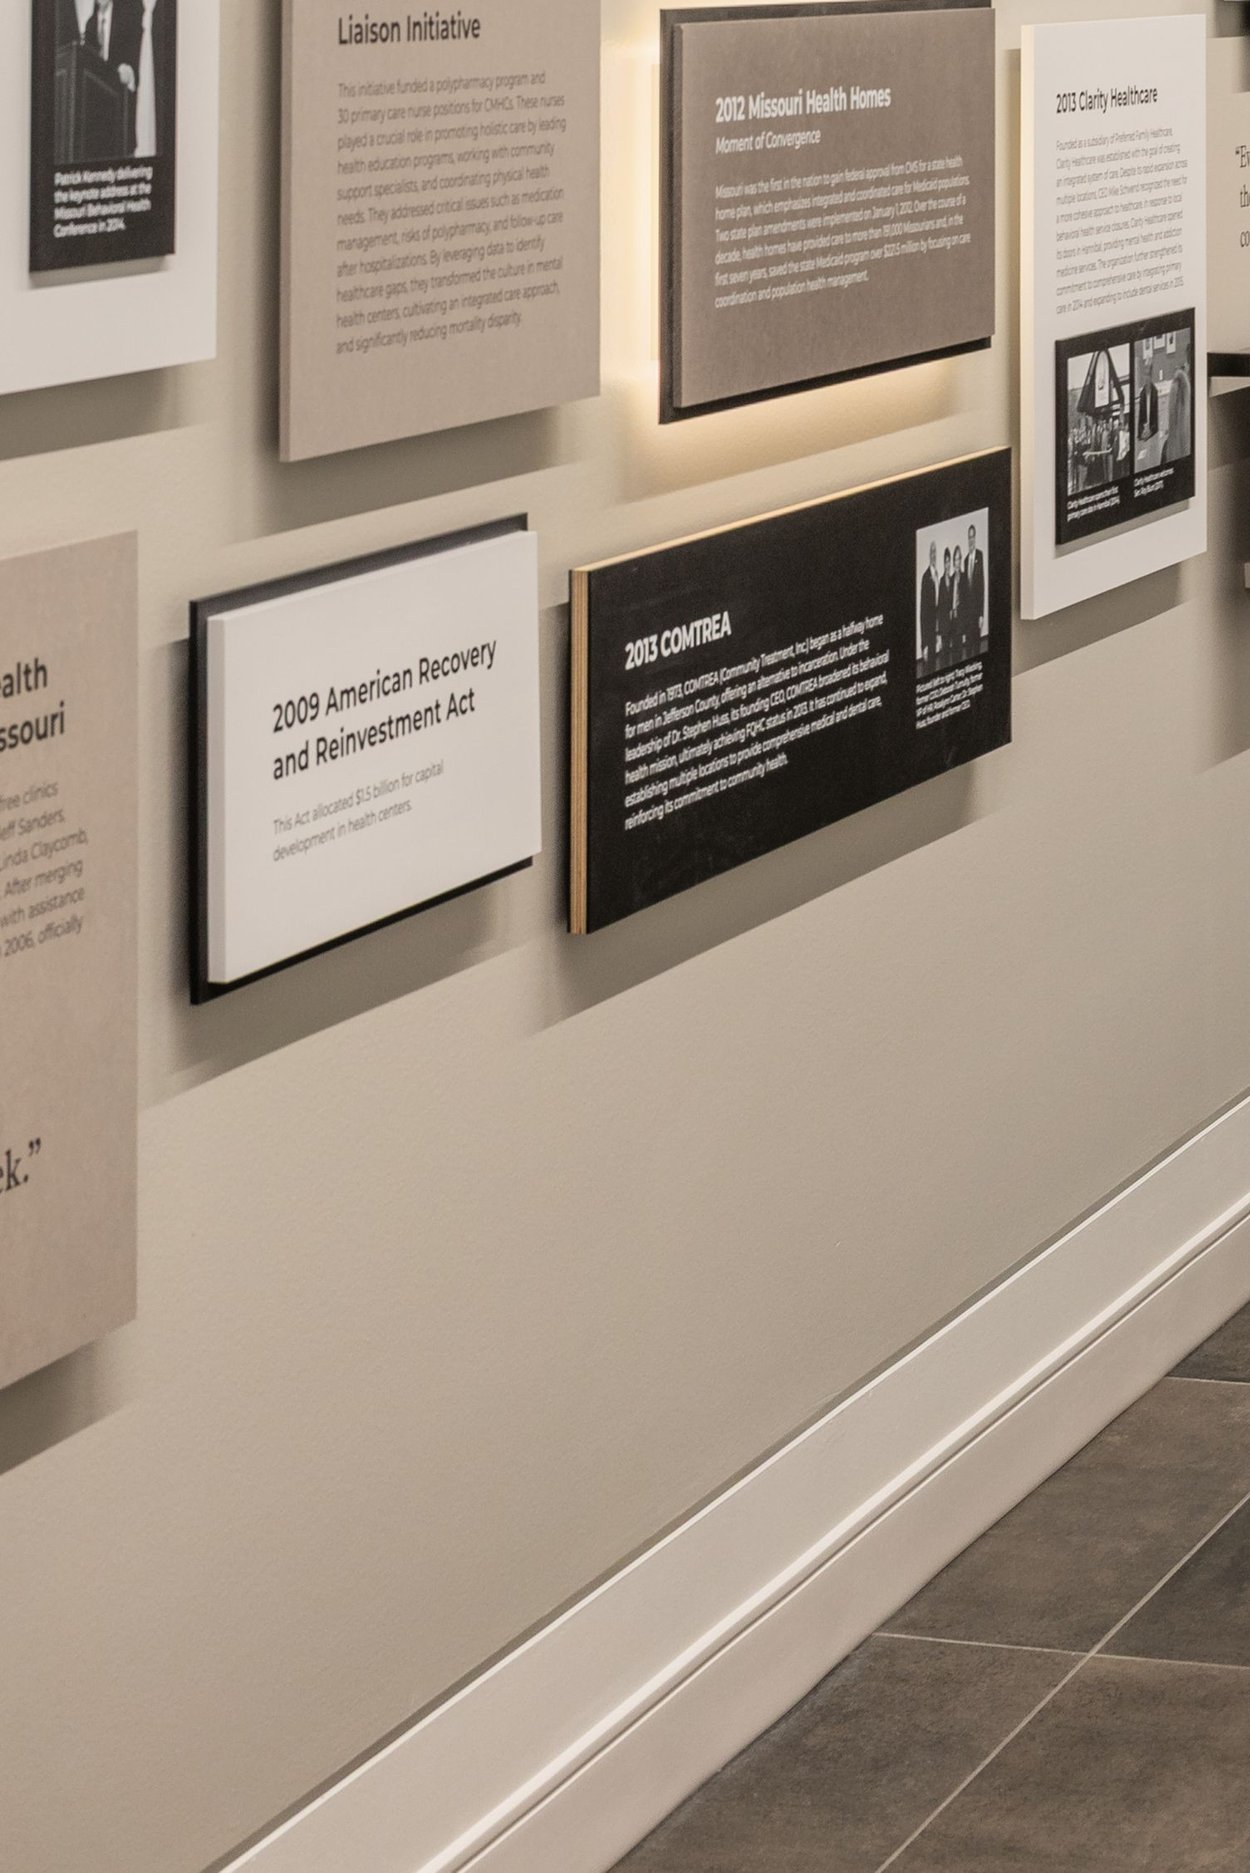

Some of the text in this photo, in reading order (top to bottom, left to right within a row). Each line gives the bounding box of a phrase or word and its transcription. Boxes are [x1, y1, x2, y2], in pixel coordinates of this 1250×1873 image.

[339, 11, 480, 45] Liaison Initiative
[716, 87, 891, 123] 2012 Missouri Health Homes
[1057, 86, 1157, 113] 2013 Clarity Healthcare
[716, 130, 821, 154] Moment of Convergence
[625, 611, 731, 670] 2013 COMTREA
[0, 658, 47, 698] alth
[273, 641, 496, 733] 2009 American Recovery
[274, 688, 475, 780] and Reinvestment Act
[23, 782, 58, 805] clinics
[273, 818, 292, 834] This
[295, 811, 310, 826] Act
[313, 792, 353, 821] allocated
[373, 778, 402, 798] billion
[401, 773, 416, 787] for
[415, 760, 443, 783] capital
[18, 809, 65, 836] Sanders.
[30, 828, 88, 860] Claycomb,
[35, 860, 83, 887] merging
[28, 888, 85, 919] assistance
[4, 915, 84, 957] 2006, officially
